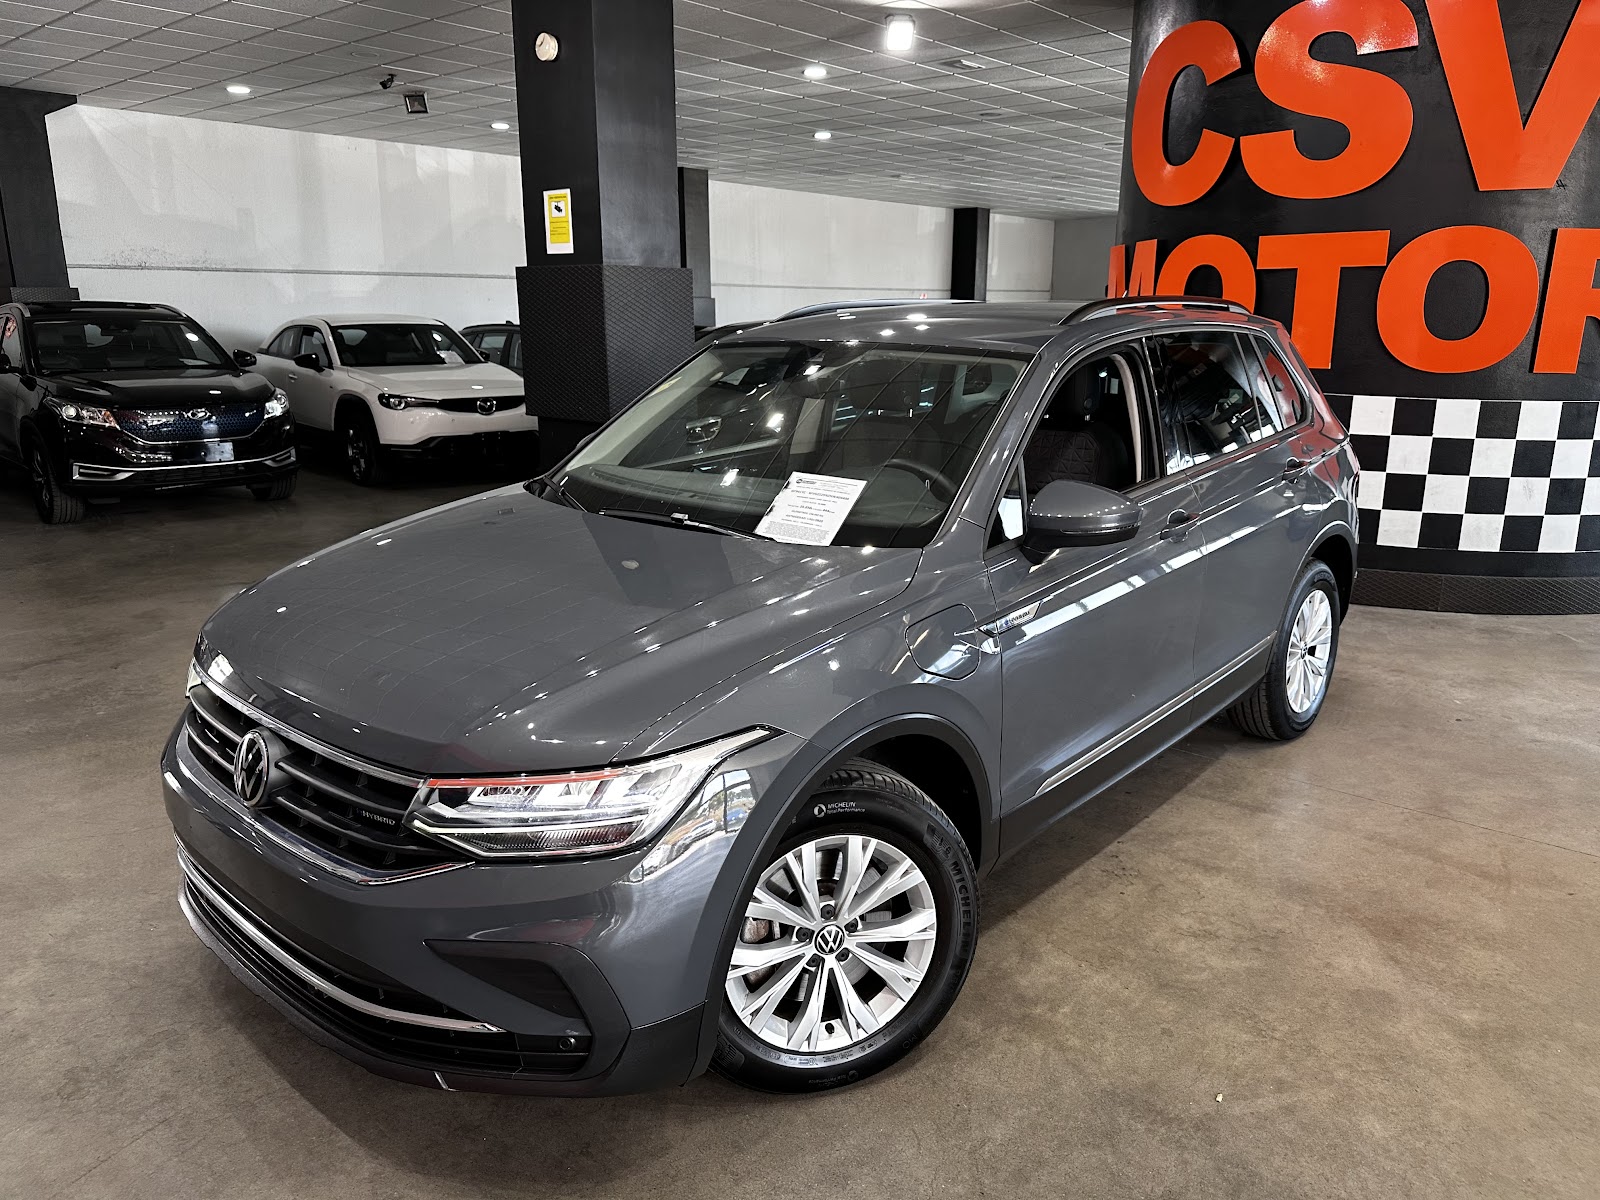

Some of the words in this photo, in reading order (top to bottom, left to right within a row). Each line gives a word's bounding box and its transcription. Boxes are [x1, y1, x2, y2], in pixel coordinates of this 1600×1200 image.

[1132, 0, 1600, 207] CSV
[827, 801, 857, 810] MICHELIN
[949, 861, 972, 954] MICHELIN
